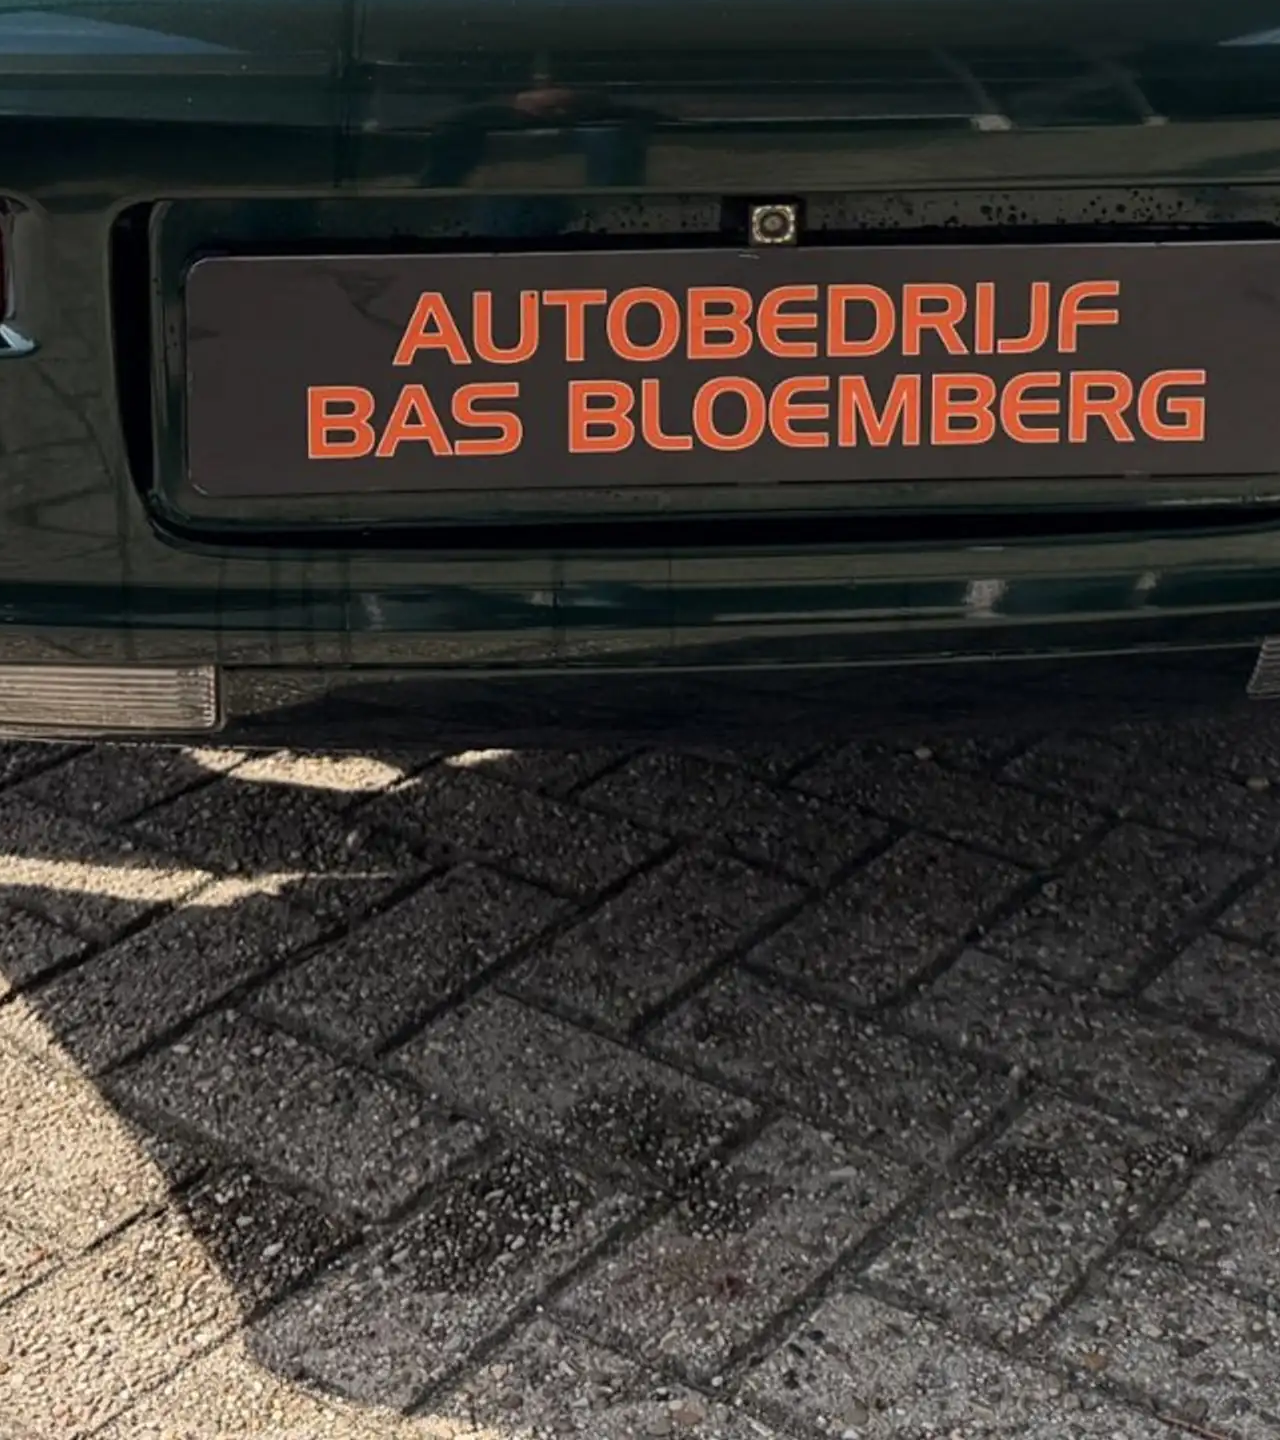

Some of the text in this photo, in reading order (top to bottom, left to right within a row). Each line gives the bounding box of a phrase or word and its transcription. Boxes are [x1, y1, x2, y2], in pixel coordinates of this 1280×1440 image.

[392, 280, 1120, 366] AUTOBEDRIJF
[307, 368, 1207, 459] BAS BLOEMBERG
